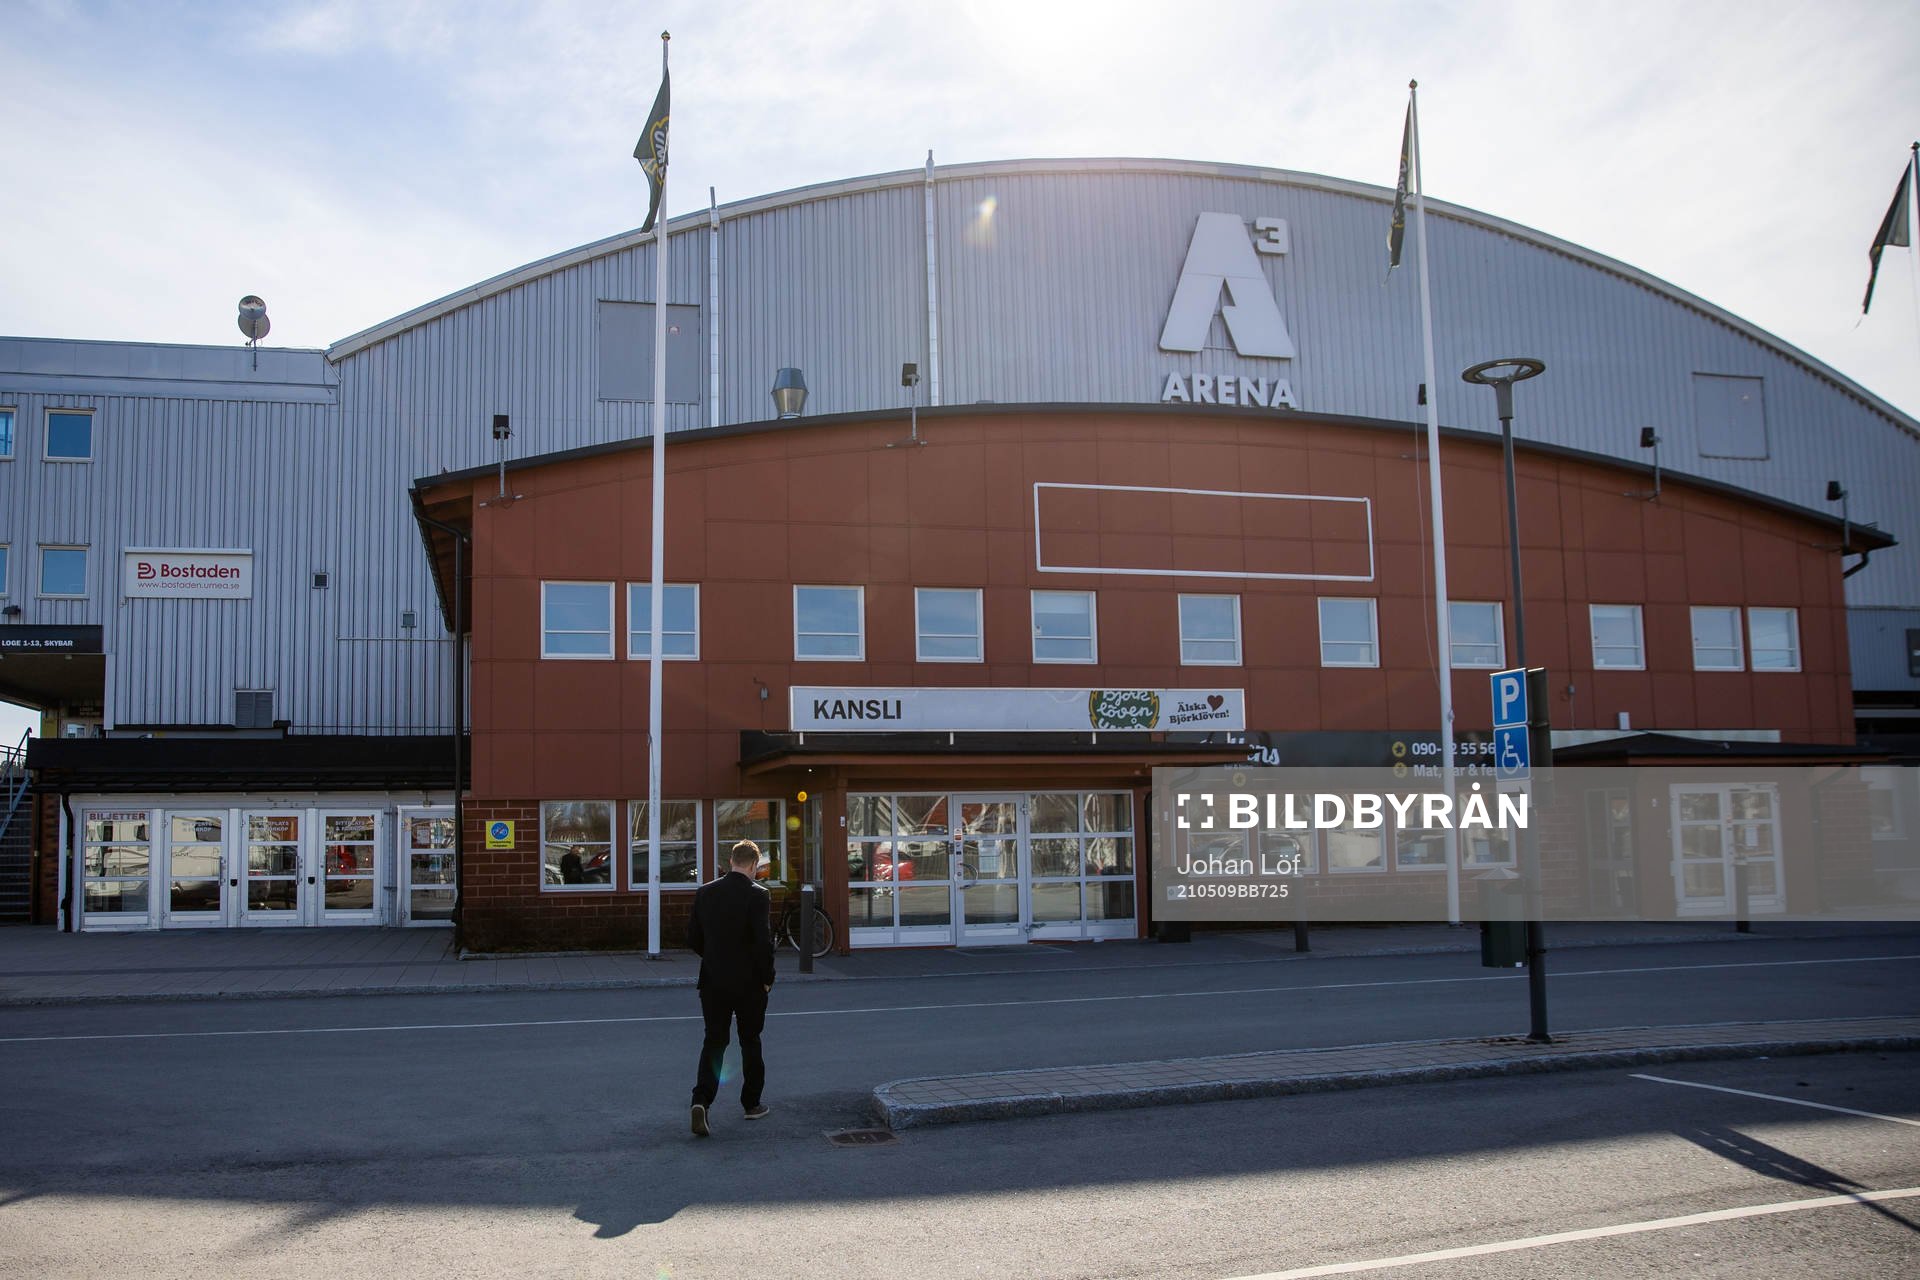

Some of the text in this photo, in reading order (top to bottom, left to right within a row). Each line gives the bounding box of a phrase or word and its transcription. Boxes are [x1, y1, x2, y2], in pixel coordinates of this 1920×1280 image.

[1161, 371, 1299, 410] ARENA
[160, 563, 240, 578] Bostaden
[137, 581, 240, 590] www.bostaden.umea.se
[1500, 677, 1520, 721] P
[814, 699, 902, 719] KANSLI
[1177, 702, 1207, 713] Älska
[1169, 709, 1230, 725] Björklöven!
[1411, 742, 1496, 755] 090-2 55 56
[1413, 764, 1442, 778] Mat,
[1468, 763, 1479, 777] &
[89, 812, 146, 820] BILJETTER
